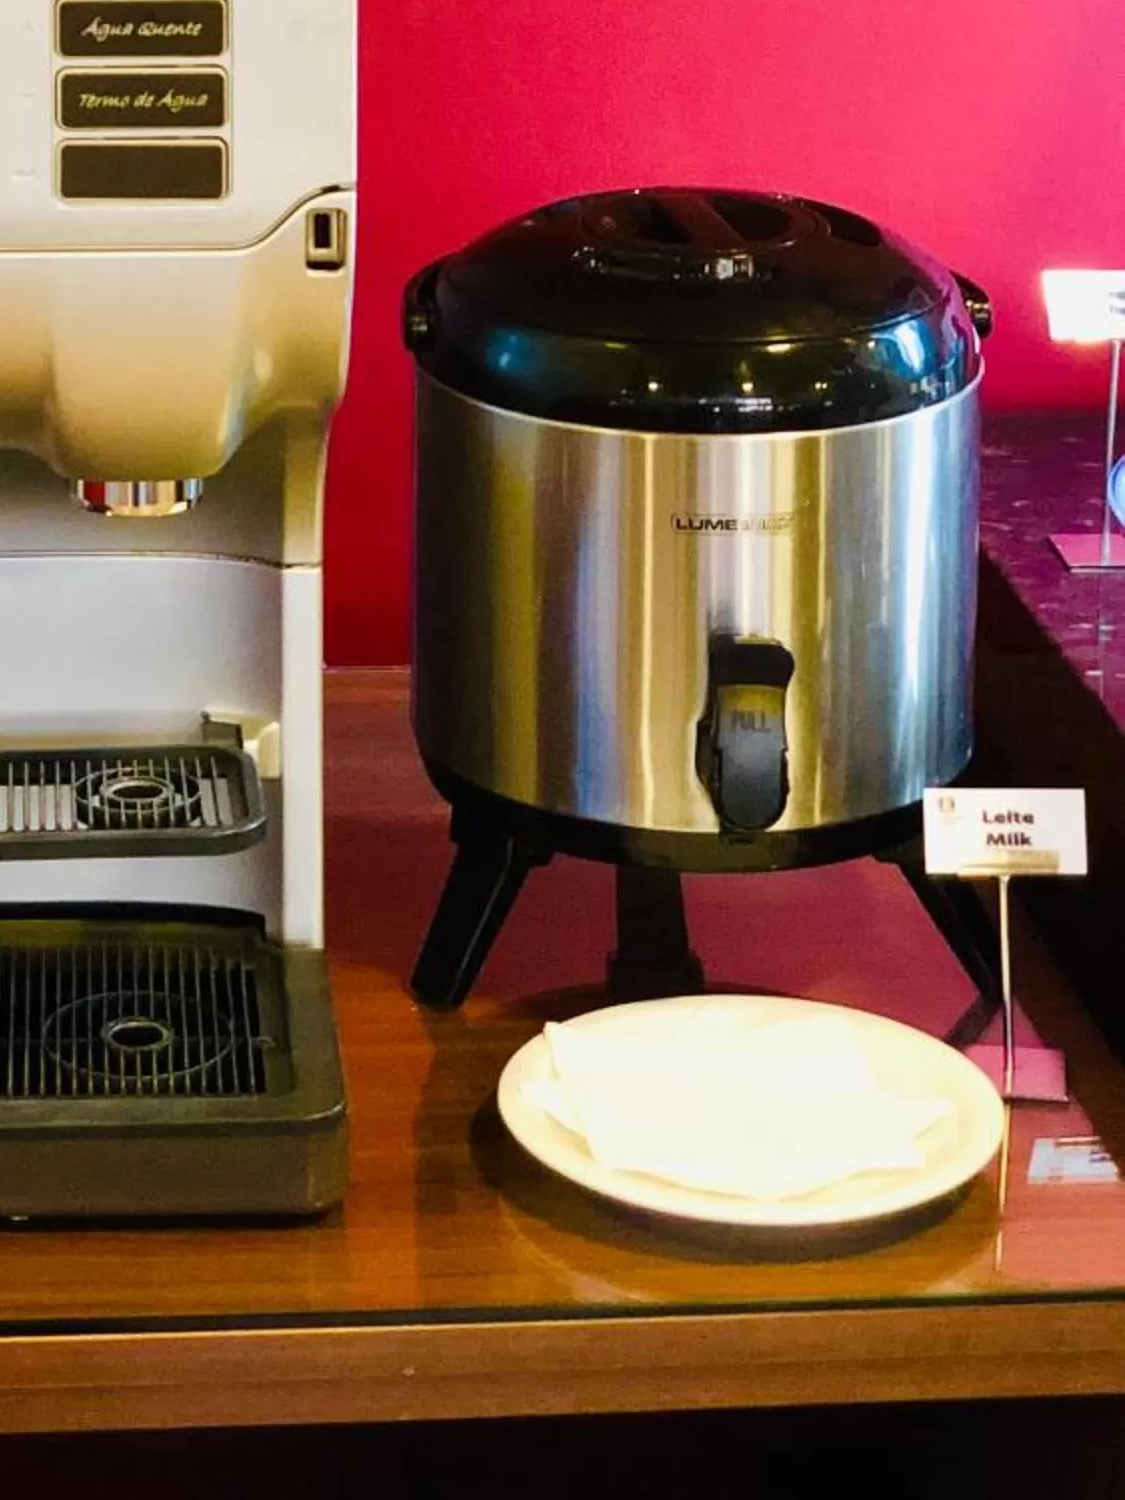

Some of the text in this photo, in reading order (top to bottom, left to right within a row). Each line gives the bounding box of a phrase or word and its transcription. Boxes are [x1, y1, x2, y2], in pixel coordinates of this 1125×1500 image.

[80, 16, 203, 42] Água Quente
[79, 92, 131, 109] Termo
[133, 91, 155, 108] de
[982, 809, 1034, 825] Leite
[986, 832, 1033, 846] Milk
